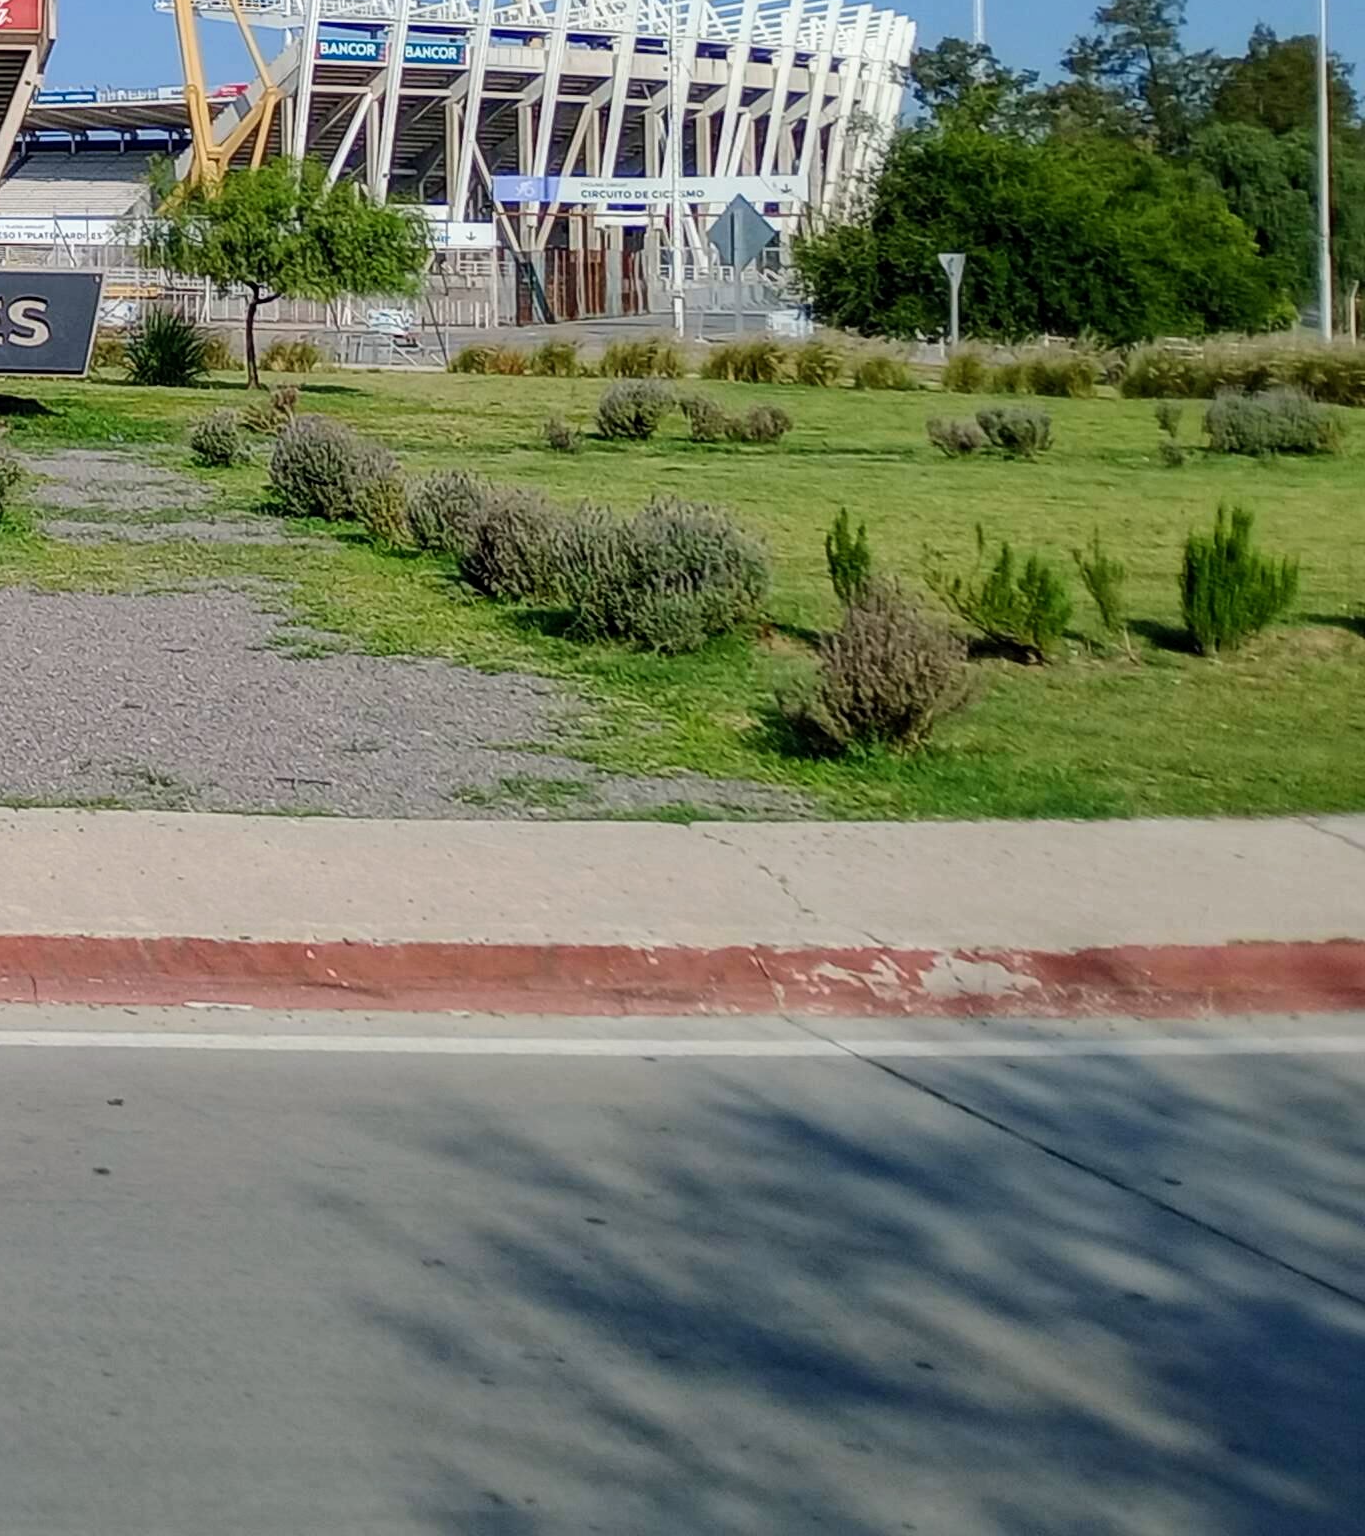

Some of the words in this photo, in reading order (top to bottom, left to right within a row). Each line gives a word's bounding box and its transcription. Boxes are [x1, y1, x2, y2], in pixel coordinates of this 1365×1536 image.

[320, 42, 376, 57] BANCOR
[405, 45, 457, 60] BANCOR
[581, 190, 632, 199] CIRCUITO
[634, 190, 648, 199] DE
